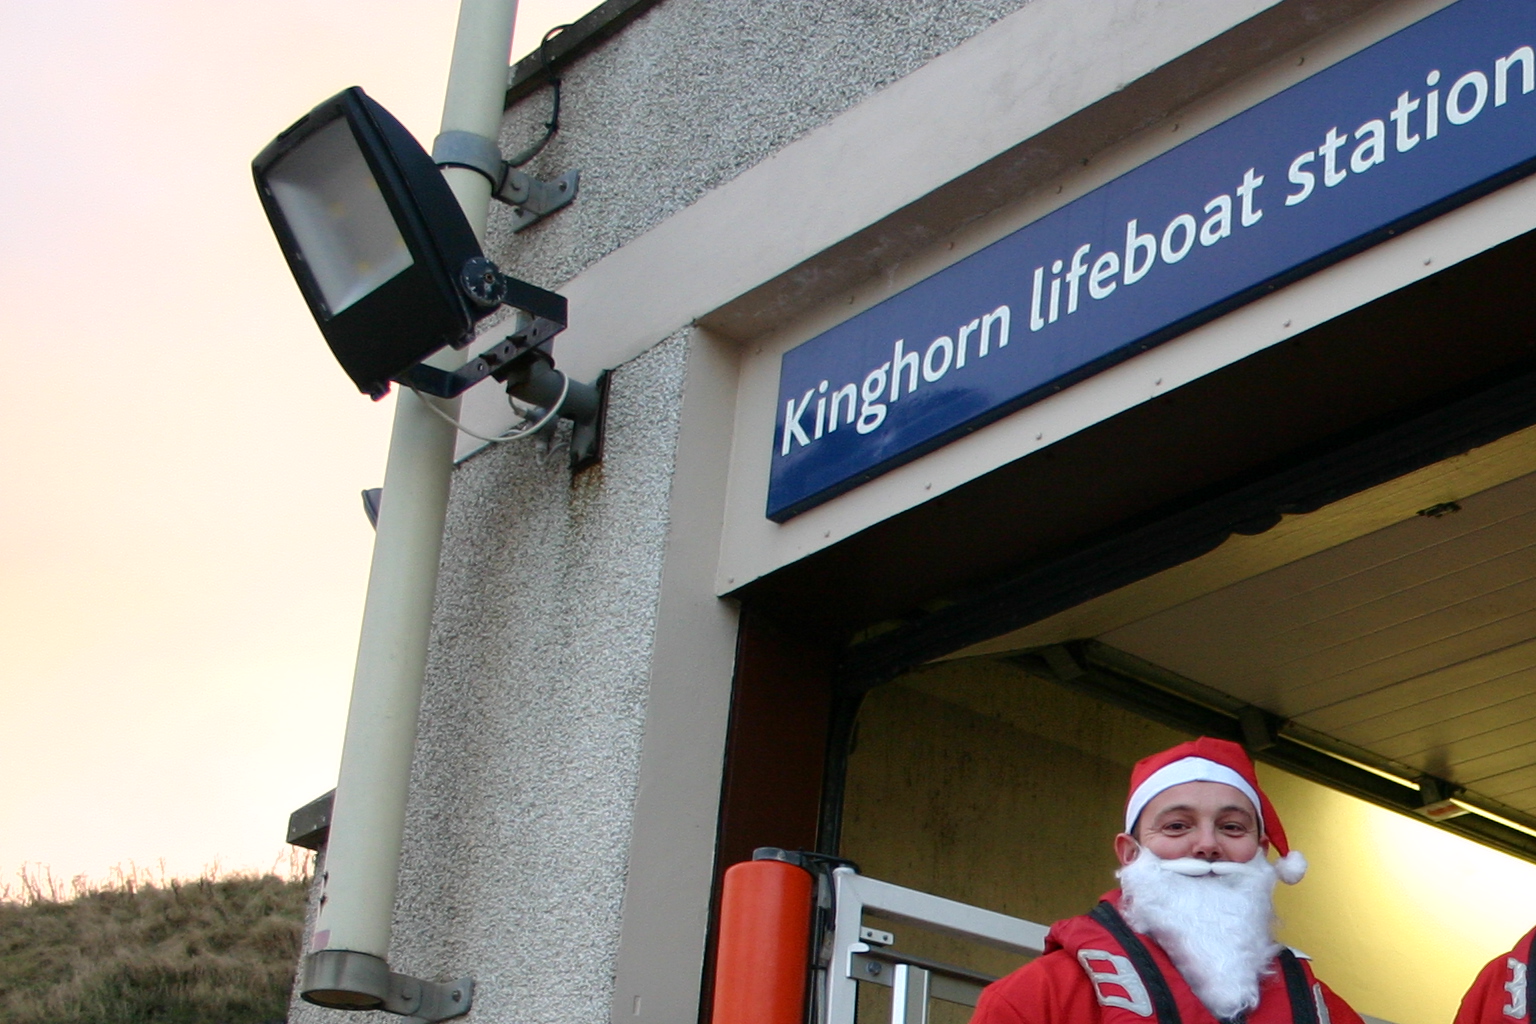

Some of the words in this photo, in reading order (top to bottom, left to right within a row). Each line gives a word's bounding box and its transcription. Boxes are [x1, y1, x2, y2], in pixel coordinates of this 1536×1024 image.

[780, 304, 1011, 458] Kinghorn
[1029, 167, 1266, 332] lifeboat
[1284, 45, 1536, 206] station
